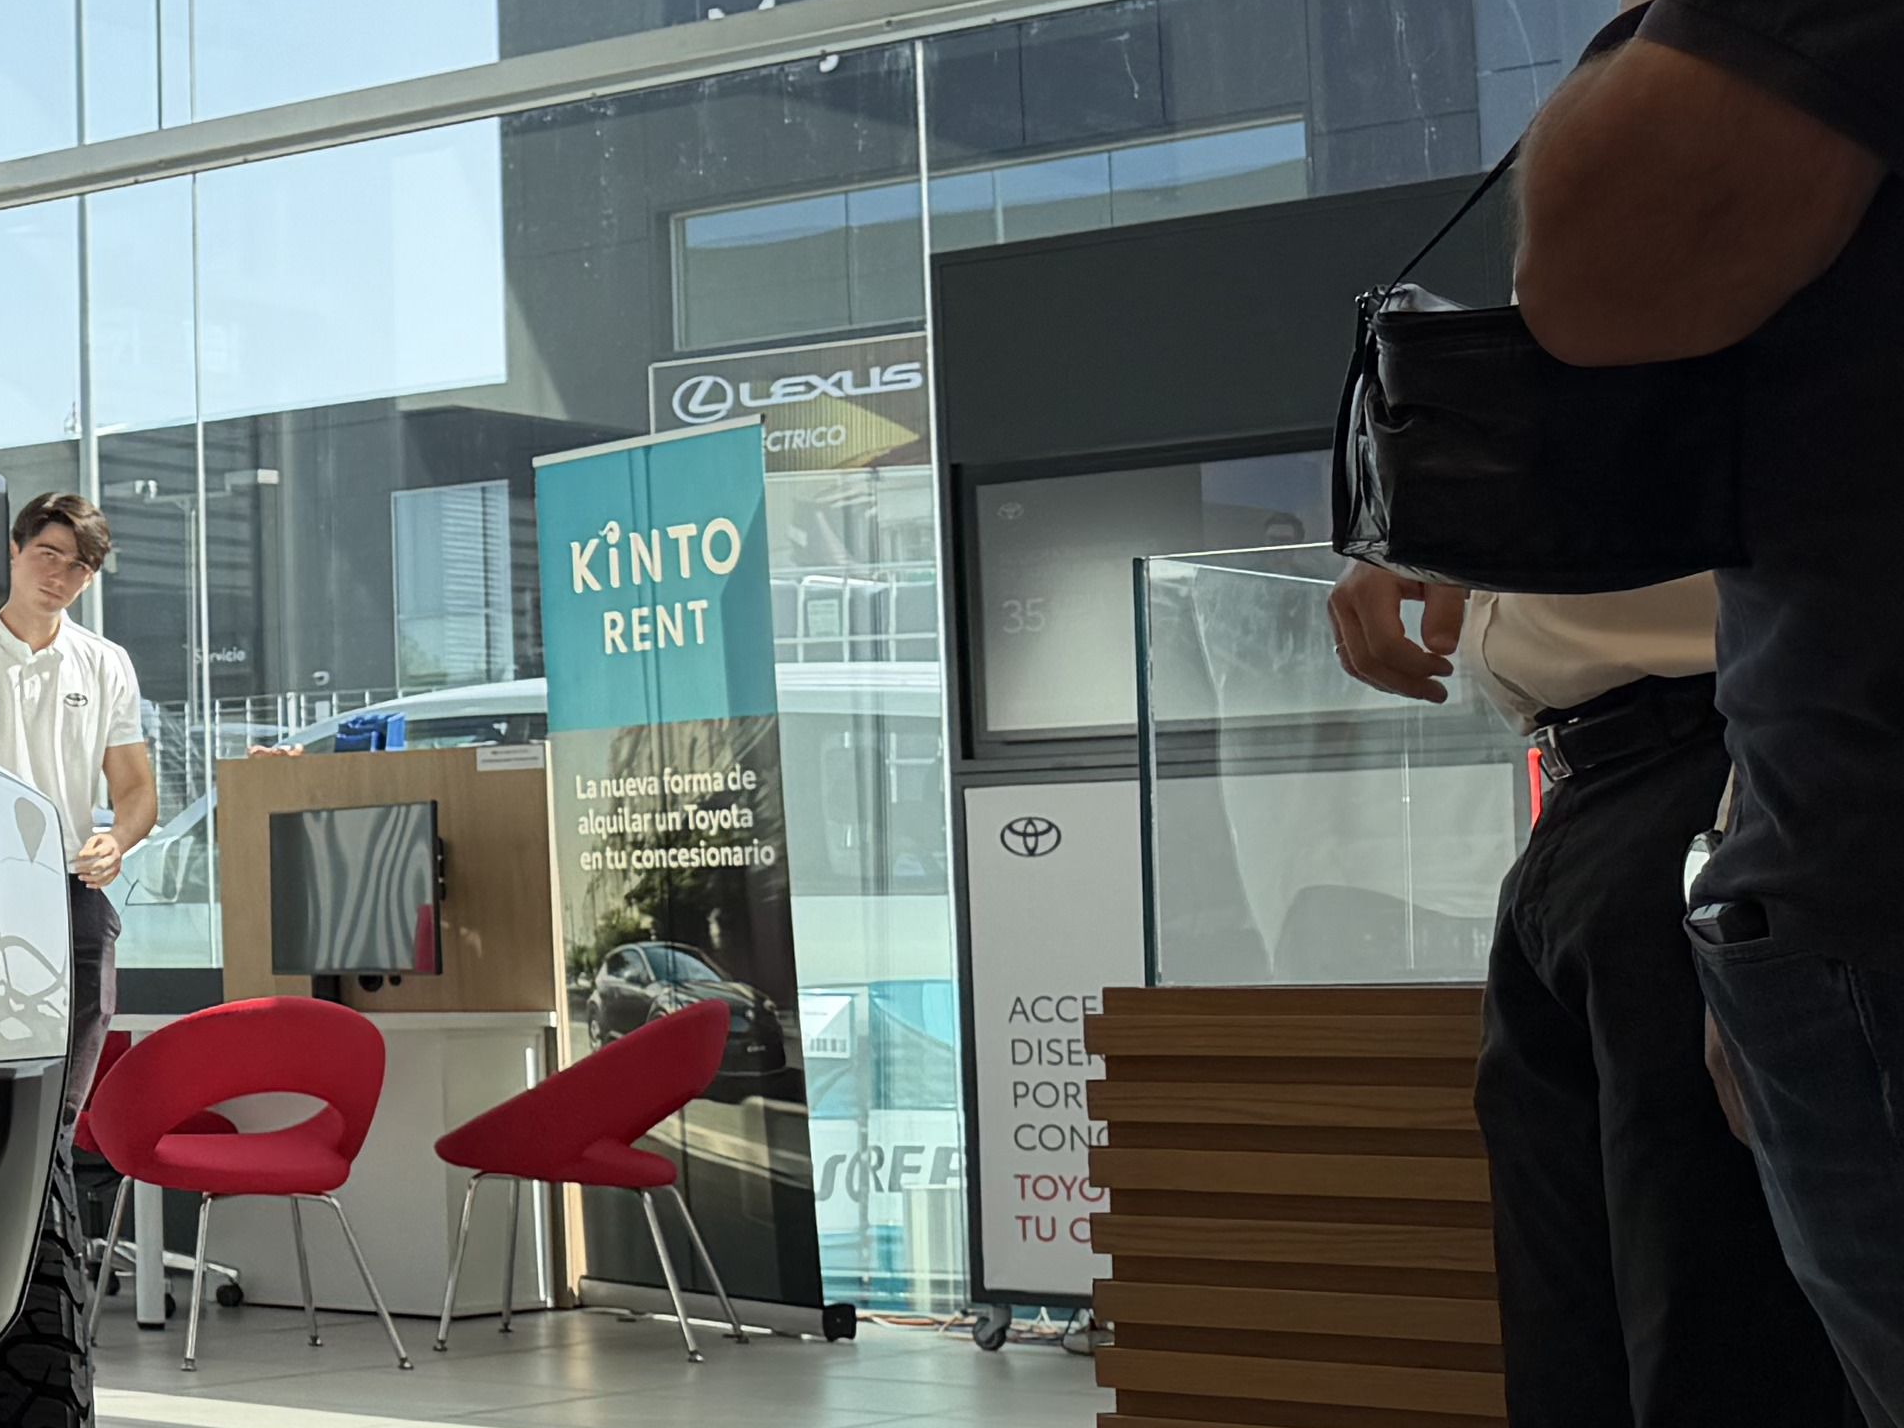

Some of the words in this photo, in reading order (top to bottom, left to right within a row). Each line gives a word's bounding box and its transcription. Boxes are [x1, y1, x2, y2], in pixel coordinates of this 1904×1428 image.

[739, 361, 924, 408] LEXUS
[763, 424, 847, 453] CTRICO
[603, 599, 709, 655] RENT
[575, 774, 597, 801] La
[600, 776, 660, 799] nueva
[663, 767, 724, 795] forma
[727, 764, 758, 791] de
[578, 808, 652, 837] alquilar
[655, 812, 682, 832] un
[685, 803, 754, 835] Toyota
[579, 850, 603, 871] en
[605, 847, 627, 870] tu
[631, 839, 776, 870] concesionario
[1013, 1080, 1083, 1109] POR
[1014, 1215, 1057, 1243] TU
